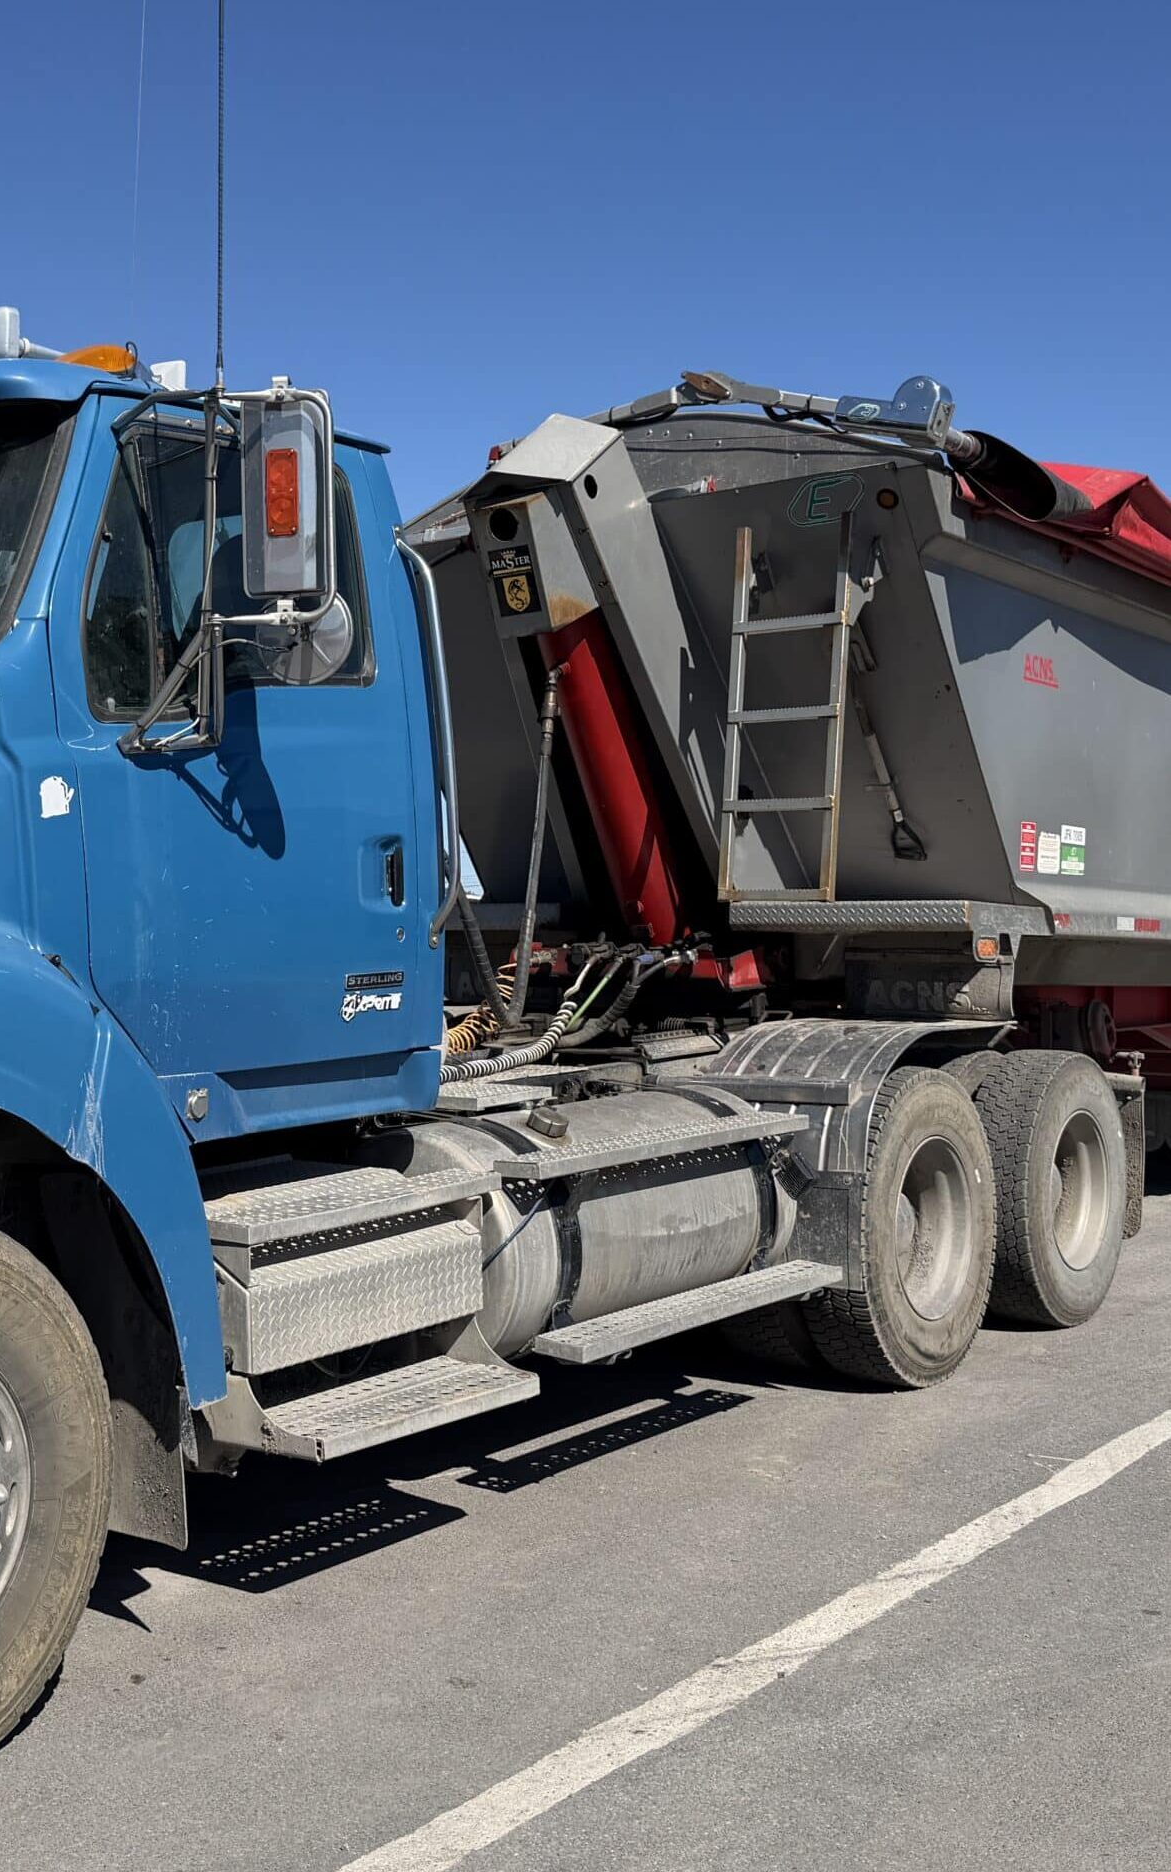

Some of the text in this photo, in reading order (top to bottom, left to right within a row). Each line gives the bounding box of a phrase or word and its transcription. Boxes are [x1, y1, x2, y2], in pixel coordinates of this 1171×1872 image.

[491, 555, 531, 570] MASTER
[1024, 653, 1054, 681] ACNS
[348, 973, 403, 985] STERLING
[866, 979, 971, 1012] ACNS
